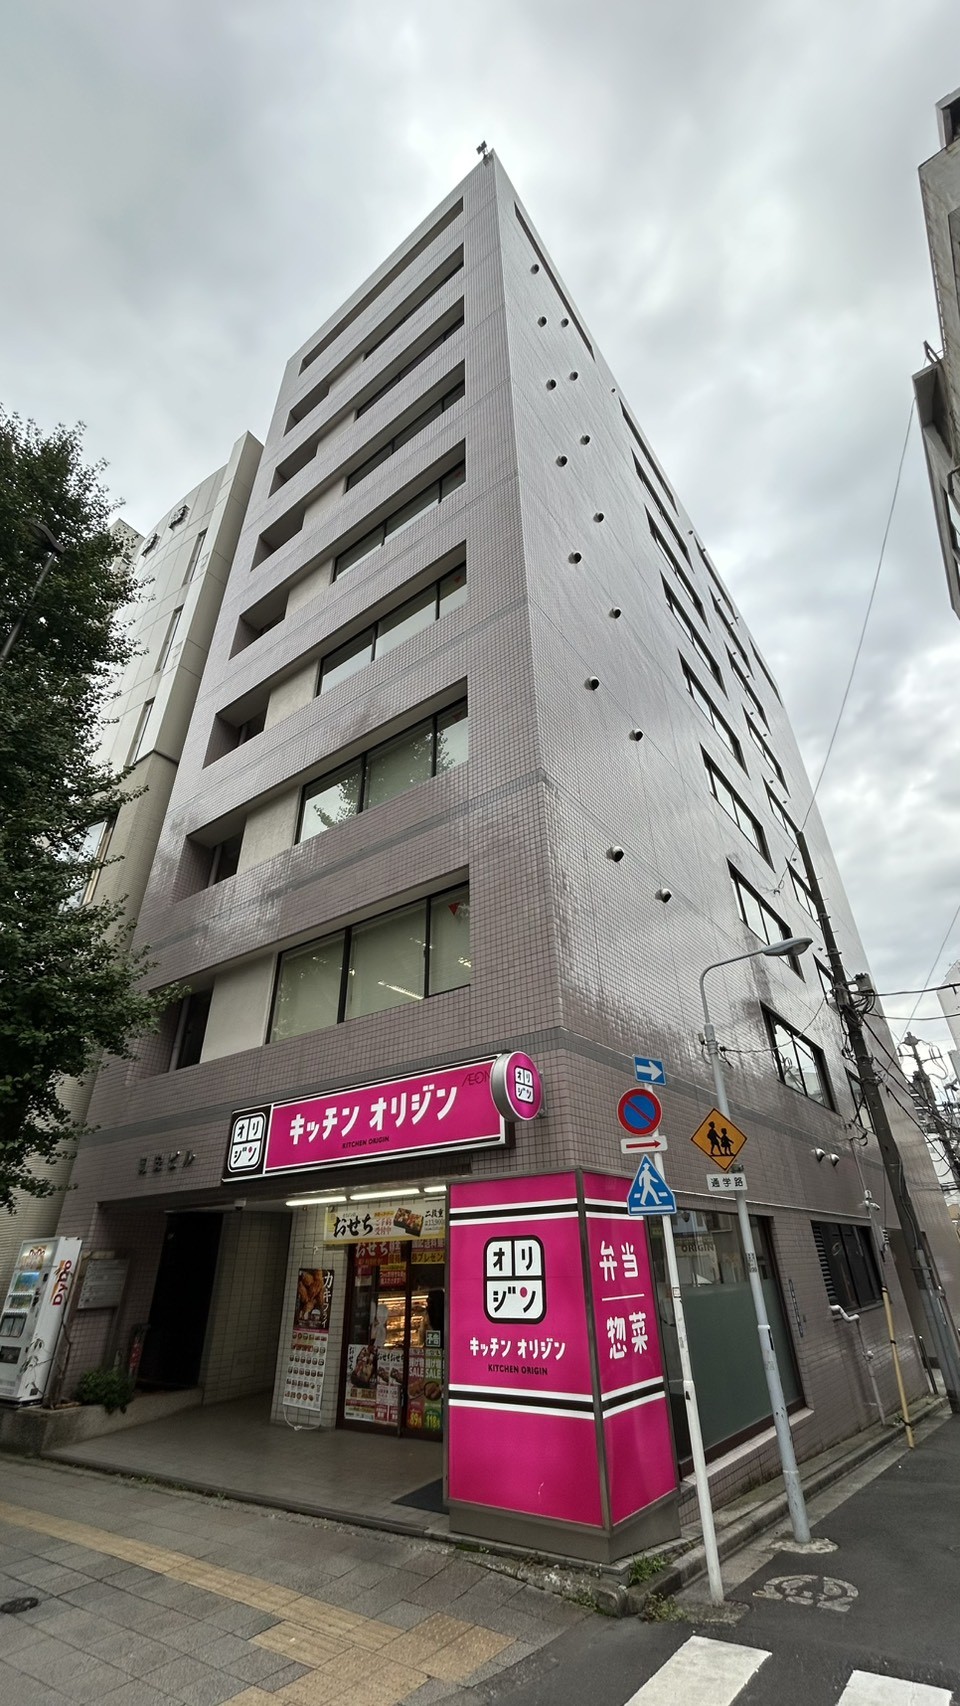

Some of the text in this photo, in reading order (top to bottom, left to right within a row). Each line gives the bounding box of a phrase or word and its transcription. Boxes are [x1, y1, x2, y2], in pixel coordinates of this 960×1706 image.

[289, 1084, 458, 1145] キッチン オリジン
[237, 1118, 260, 1140] オリ
[342, 1135, 390, 1149] KITCHEN ORIGIN
[232, 1145, 257, 1164] ジン
[710, 1177, 744, 1188] 通学路
[333, 1213, 373, 1237] おせち
[355, 1242, 389, 1258] おせち
[493, 1246, 533, 1272] オリ
[599, 1240, 639, 1282] 弁当
[322, 1271, 334, 1329] カキフライ
[492, 1286, 537, 1313] ジン
[606, 1311, 649, 1360] 惣菜
[469, 1337, 566, 1360] キッチン オリジン
[409, 1366, 424, 1377] SALE
[425, 1368, 441, 1379] SALE
[488, 1364, 548, 1375] KITCHEN ORIGIN
